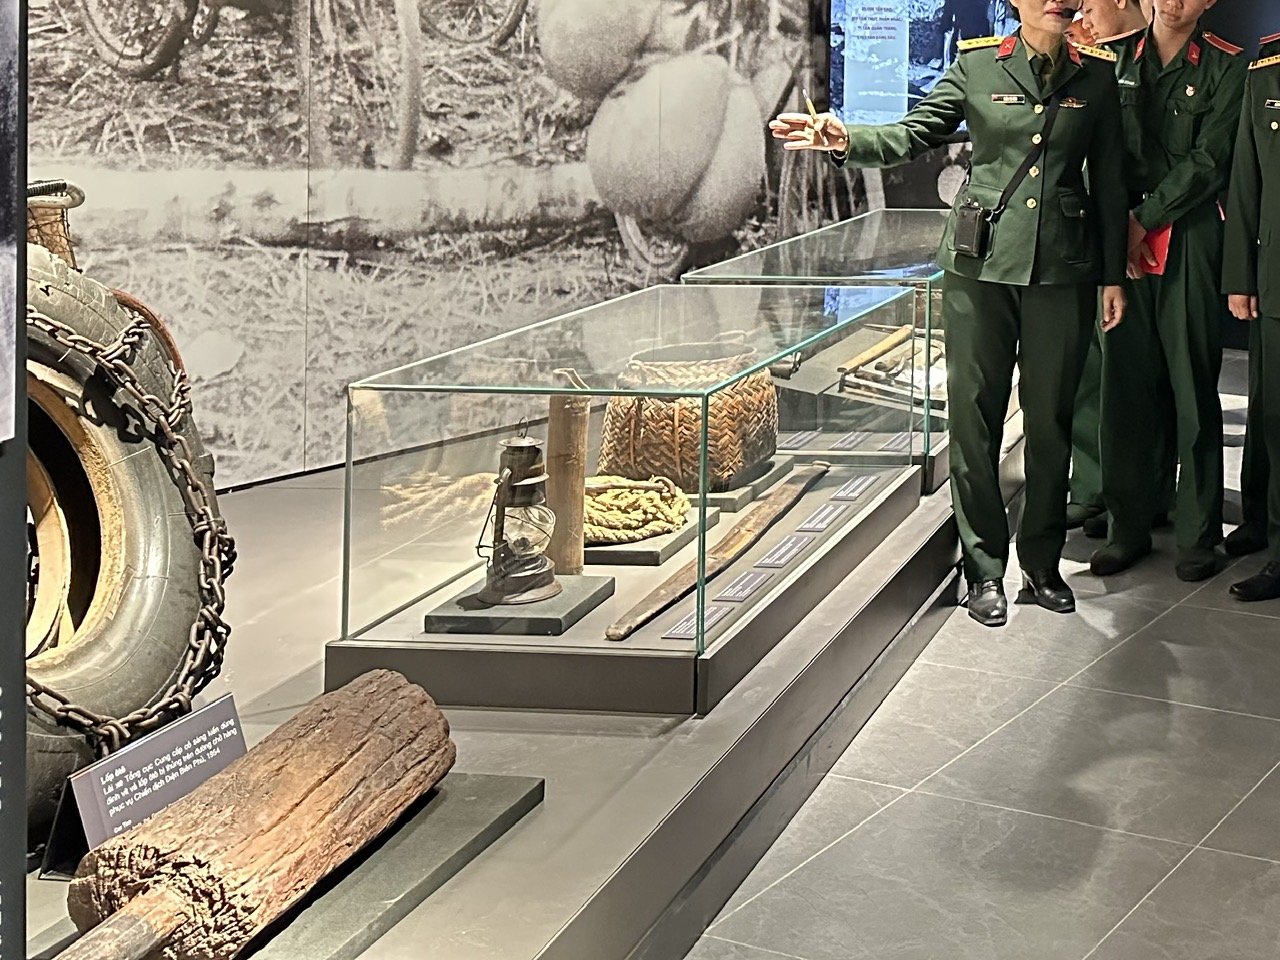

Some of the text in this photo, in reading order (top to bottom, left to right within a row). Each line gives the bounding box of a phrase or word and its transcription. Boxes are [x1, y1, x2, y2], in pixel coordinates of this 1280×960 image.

[108, 802, 125, 818] phục
[134, 786, 152, 801] Chiến
[152, 778, 165, 791] dịch
[165, 770, 179, 783] Điện
[179, 763, 193, 775] Biên
[207, 747, 221, 759] 1954
[124, 770, 141, 783] Tổng
[142, 763, 154, 774] cục
[154, 753, 171, 767] Cung
[172, 745, 183, 757] cấp
